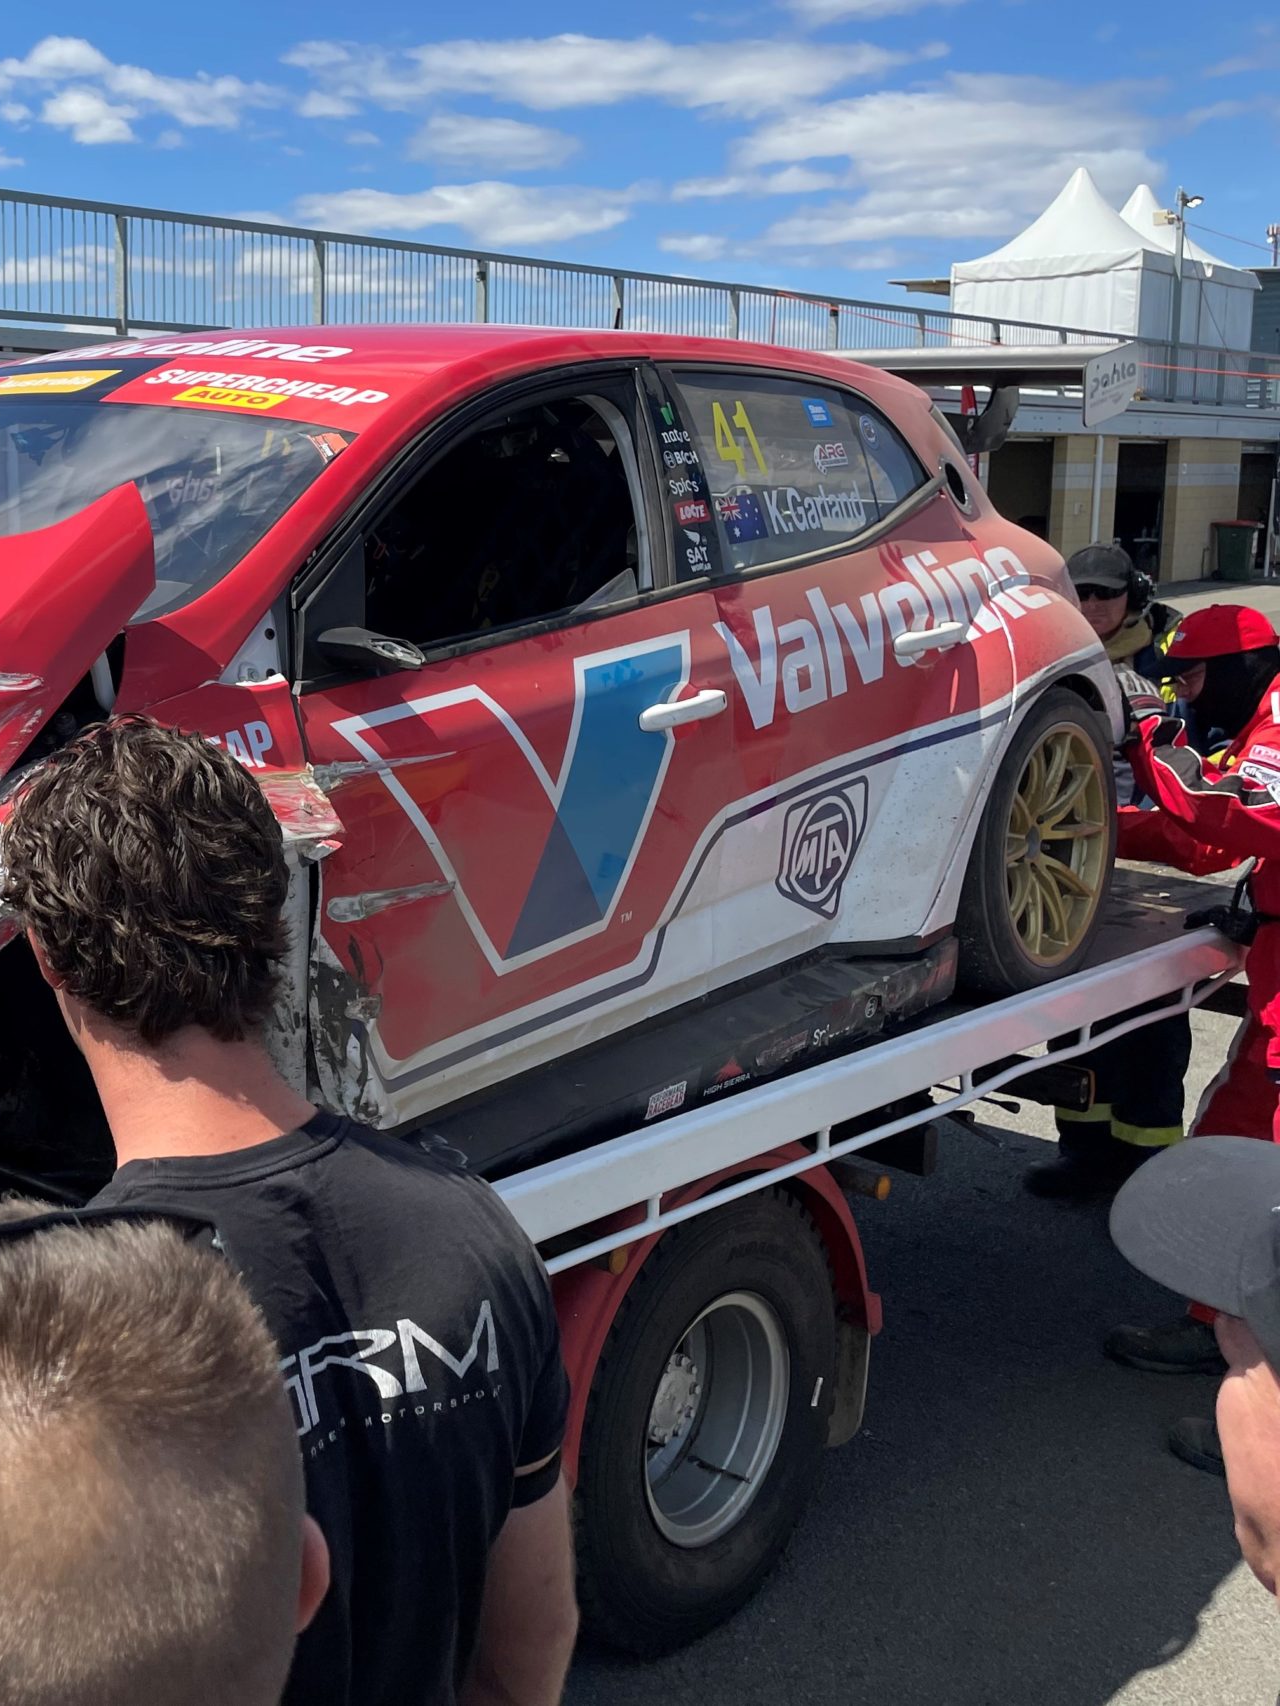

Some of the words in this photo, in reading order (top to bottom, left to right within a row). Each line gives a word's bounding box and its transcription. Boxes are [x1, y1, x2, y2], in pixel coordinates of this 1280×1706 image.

[145, 369, 390, 406] SUPERCHEAP
[188, 388, 271, 405] AUTO
[712, 400, 769, 477] 41
[819, 442, 846, 461] ARG
[763, 481, 866, 536] K.Garland
[686, 545, 709, 565] SAT
[713, 546, 1054, 731] Valvoline
[205, 720, 274, 768] AP
[621, 911, 632, 923] TM
[703, 1082, 723, 1097] HIGH
[724, 1072, 751, 1089] SIERRA
